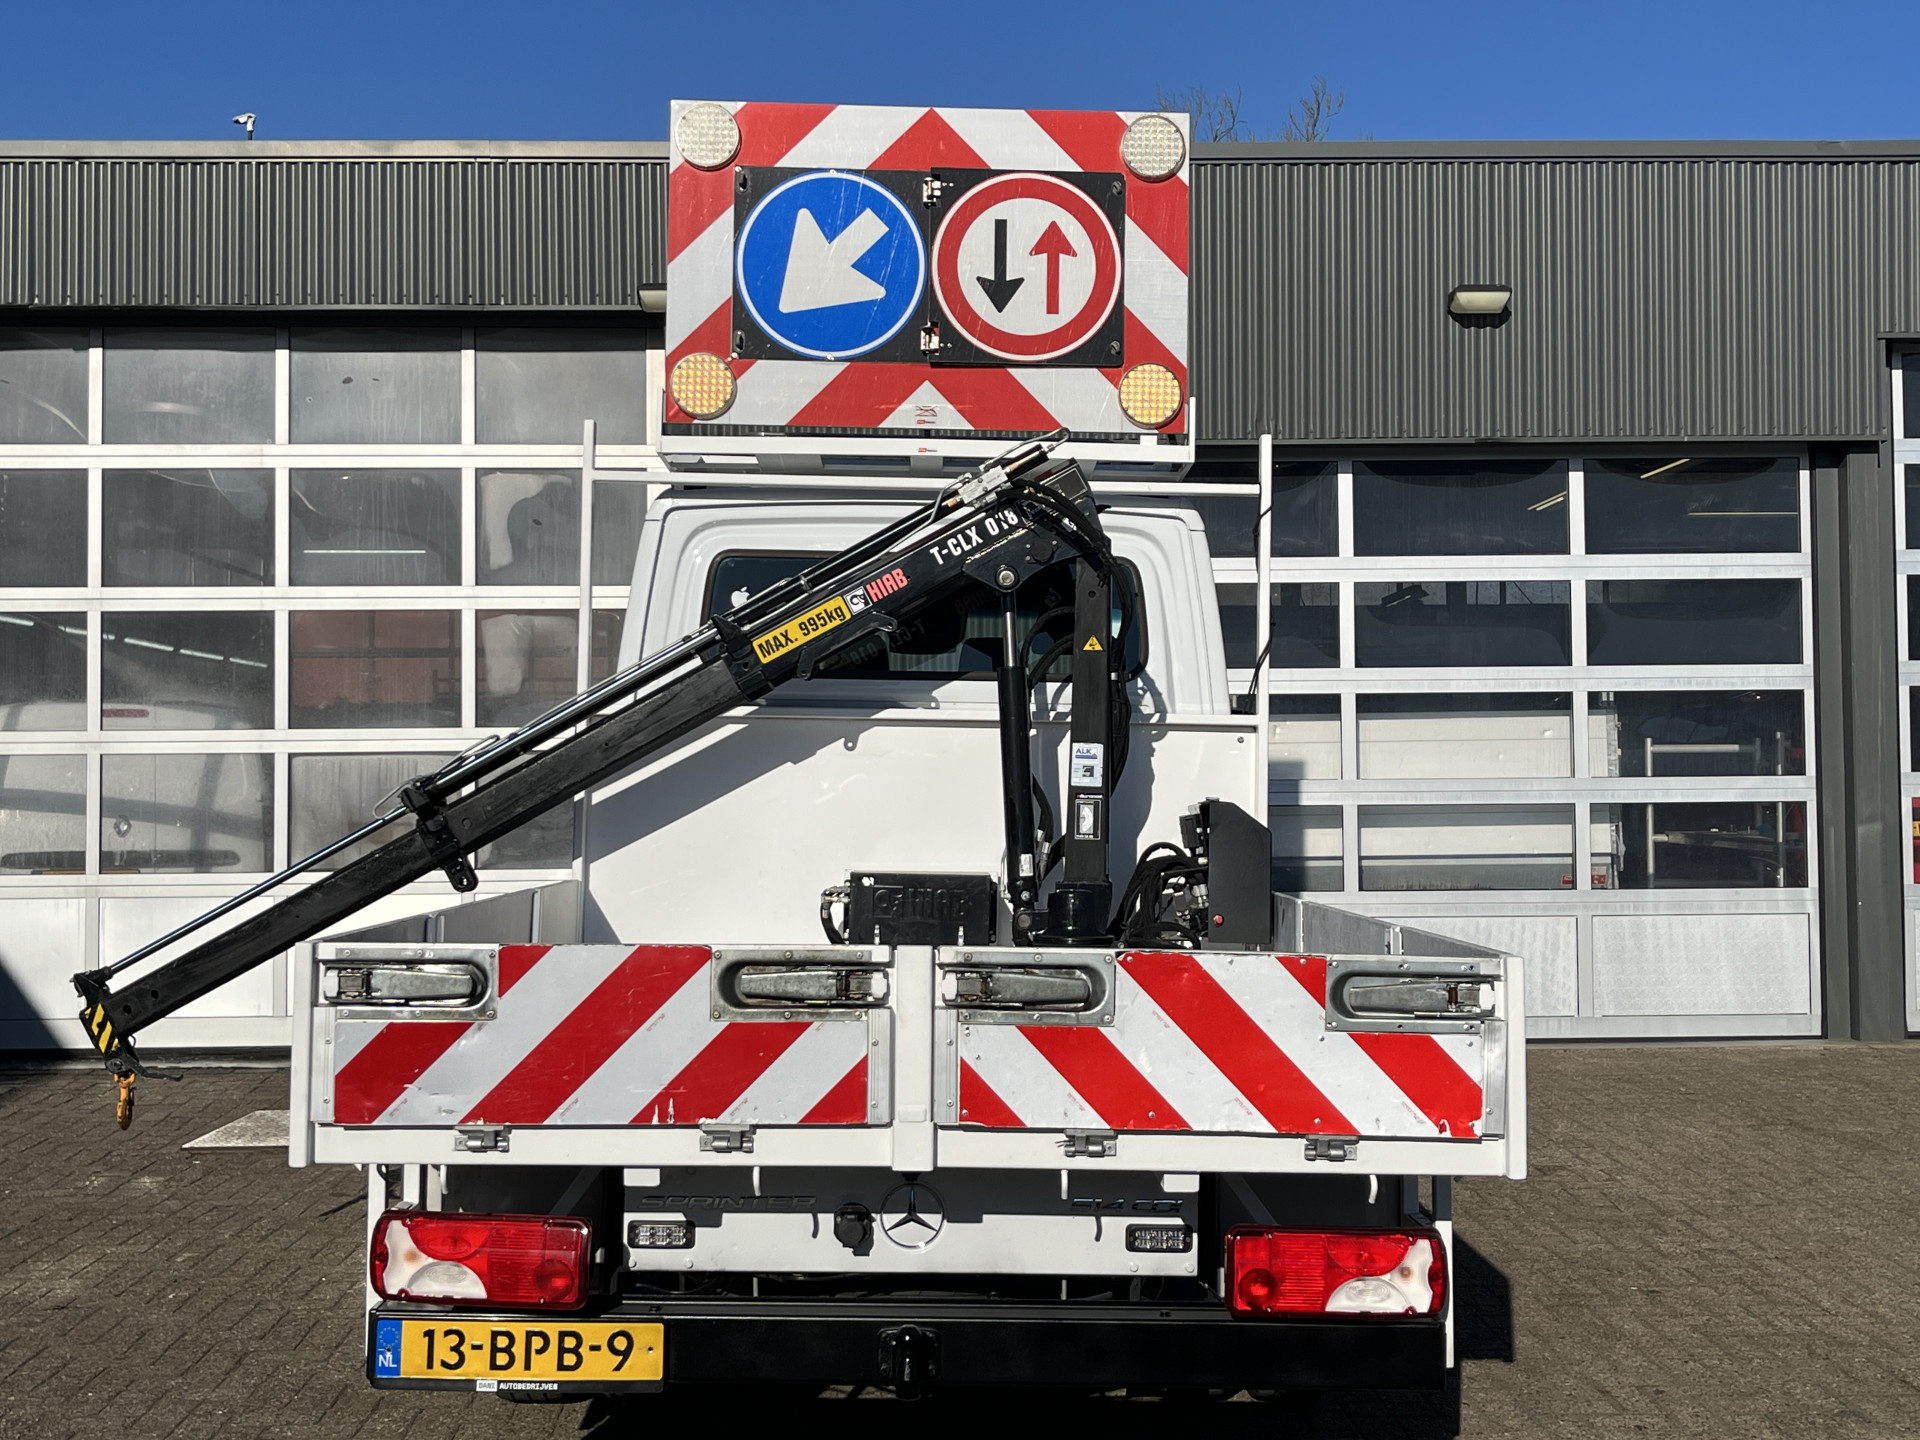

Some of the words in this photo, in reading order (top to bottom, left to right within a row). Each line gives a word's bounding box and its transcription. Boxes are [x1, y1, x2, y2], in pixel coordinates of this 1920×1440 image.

[929, 525, 983, 565] T-CLX
[866, 568, 909, 602] HIAB
[757, 631, 799, 660] MAX.
[798, 604, 846, 637] 995kg
[1075, 747, 1092, 755] ALK
[639, 1195, 816, 1210] SPRINTER
[378, 1353, 398, 1368] NL
[422, 1328, 635, 1372] 13-BPB-9
[499, 1382, 559, 1391] AUTOBEDRIJVEN
